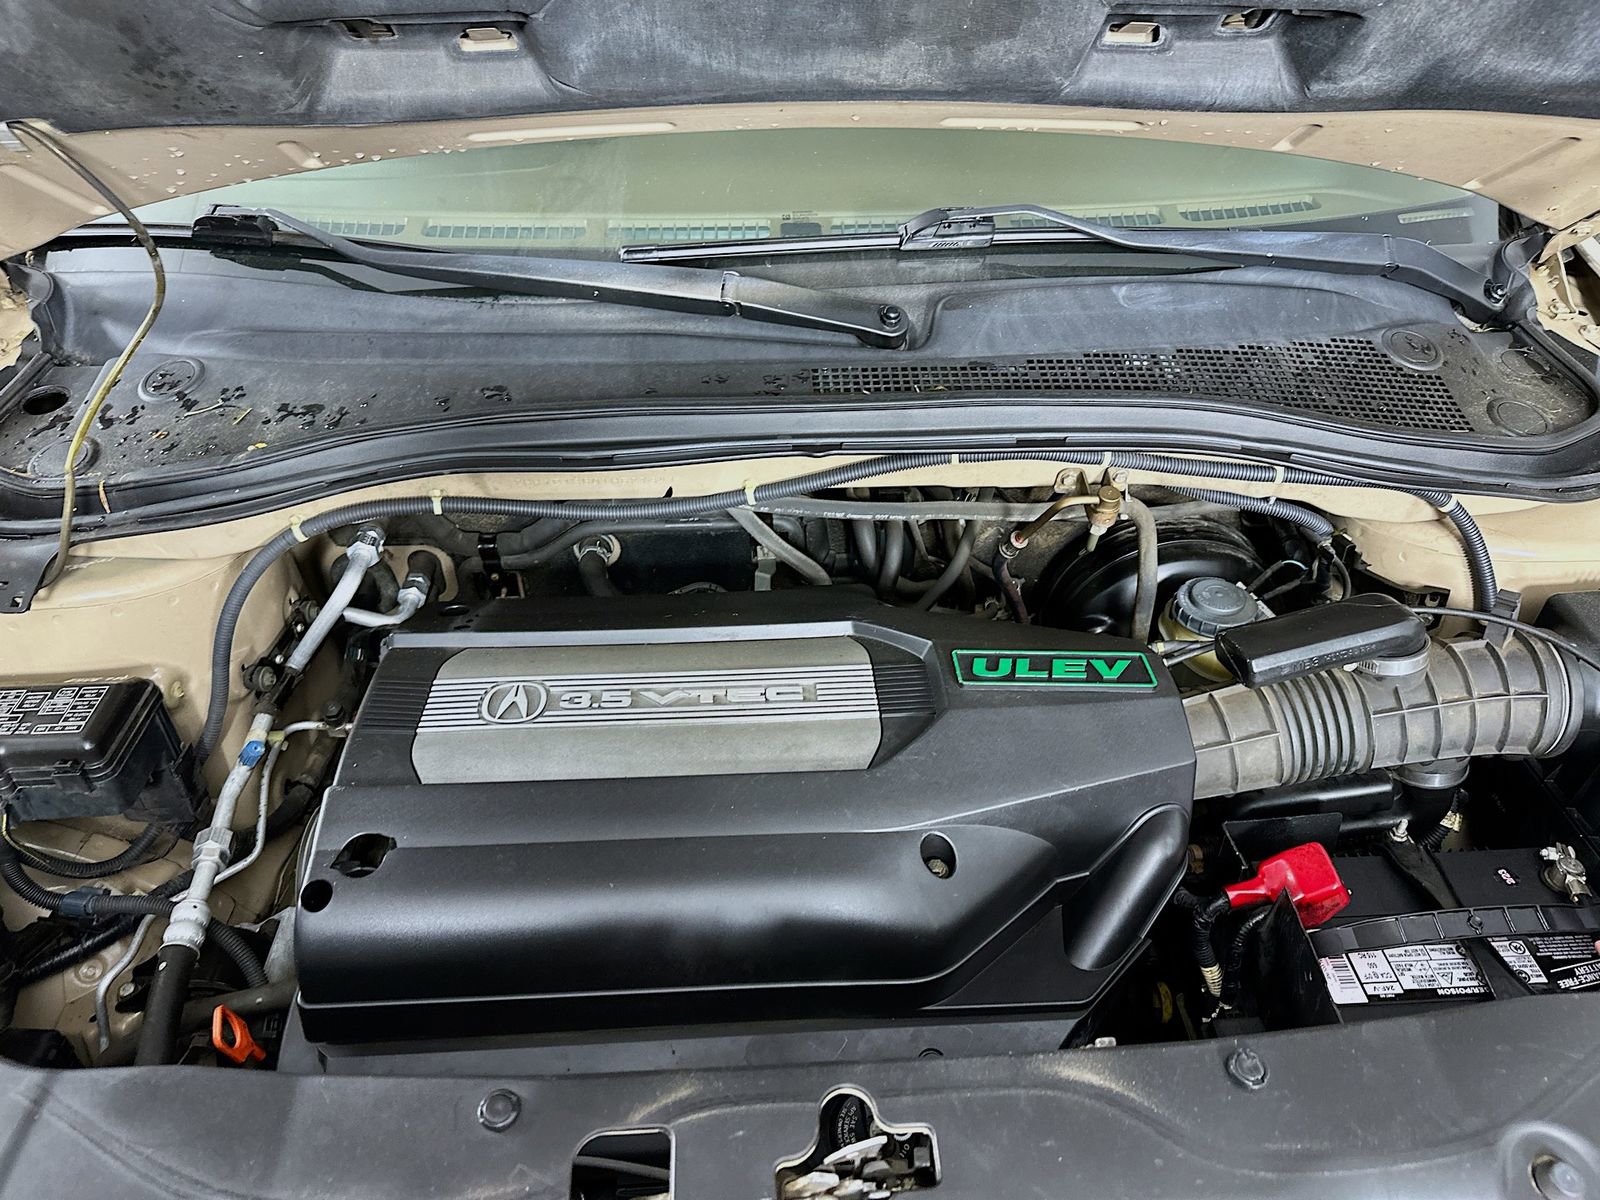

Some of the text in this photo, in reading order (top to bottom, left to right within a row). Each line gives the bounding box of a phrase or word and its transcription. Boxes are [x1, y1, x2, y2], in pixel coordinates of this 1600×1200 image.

[971, 657, 1132, 680] ULEV
[560, 683, 804, 709] 3.5 VTEC
[1557, 972, 1600, 989] ANCE-FREE
